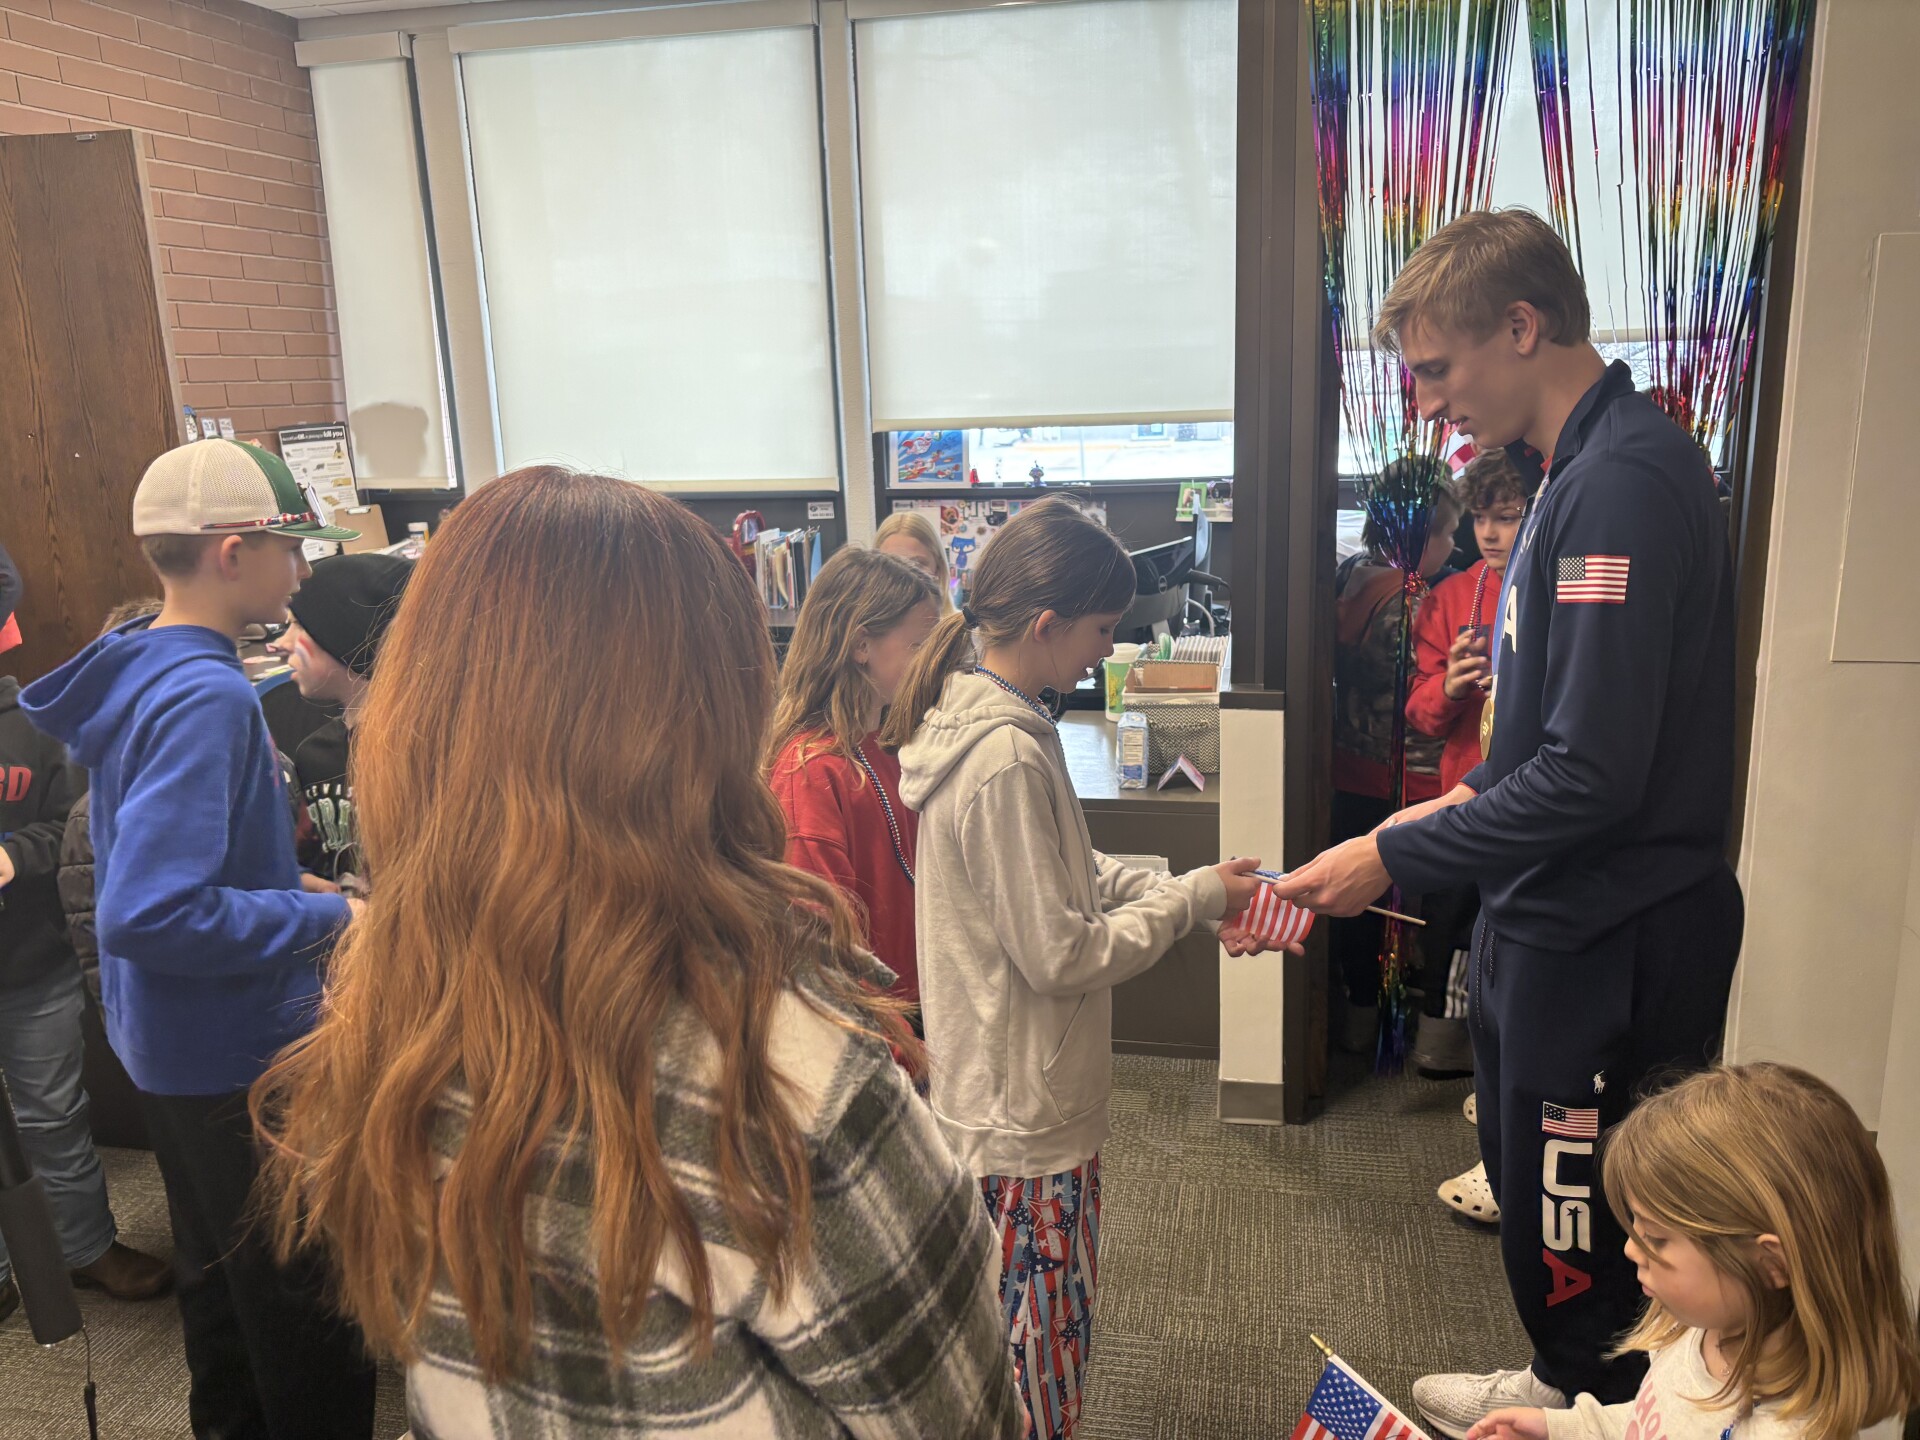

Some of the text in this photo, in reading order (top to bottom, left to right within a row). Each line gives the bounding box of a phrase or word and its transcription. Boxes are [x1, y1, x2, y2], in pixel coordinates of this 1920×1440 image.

[332, 431, 343, 439] you
[0, 766, 32, 801] D
[1542, 1138, 1593, 1307] USA
